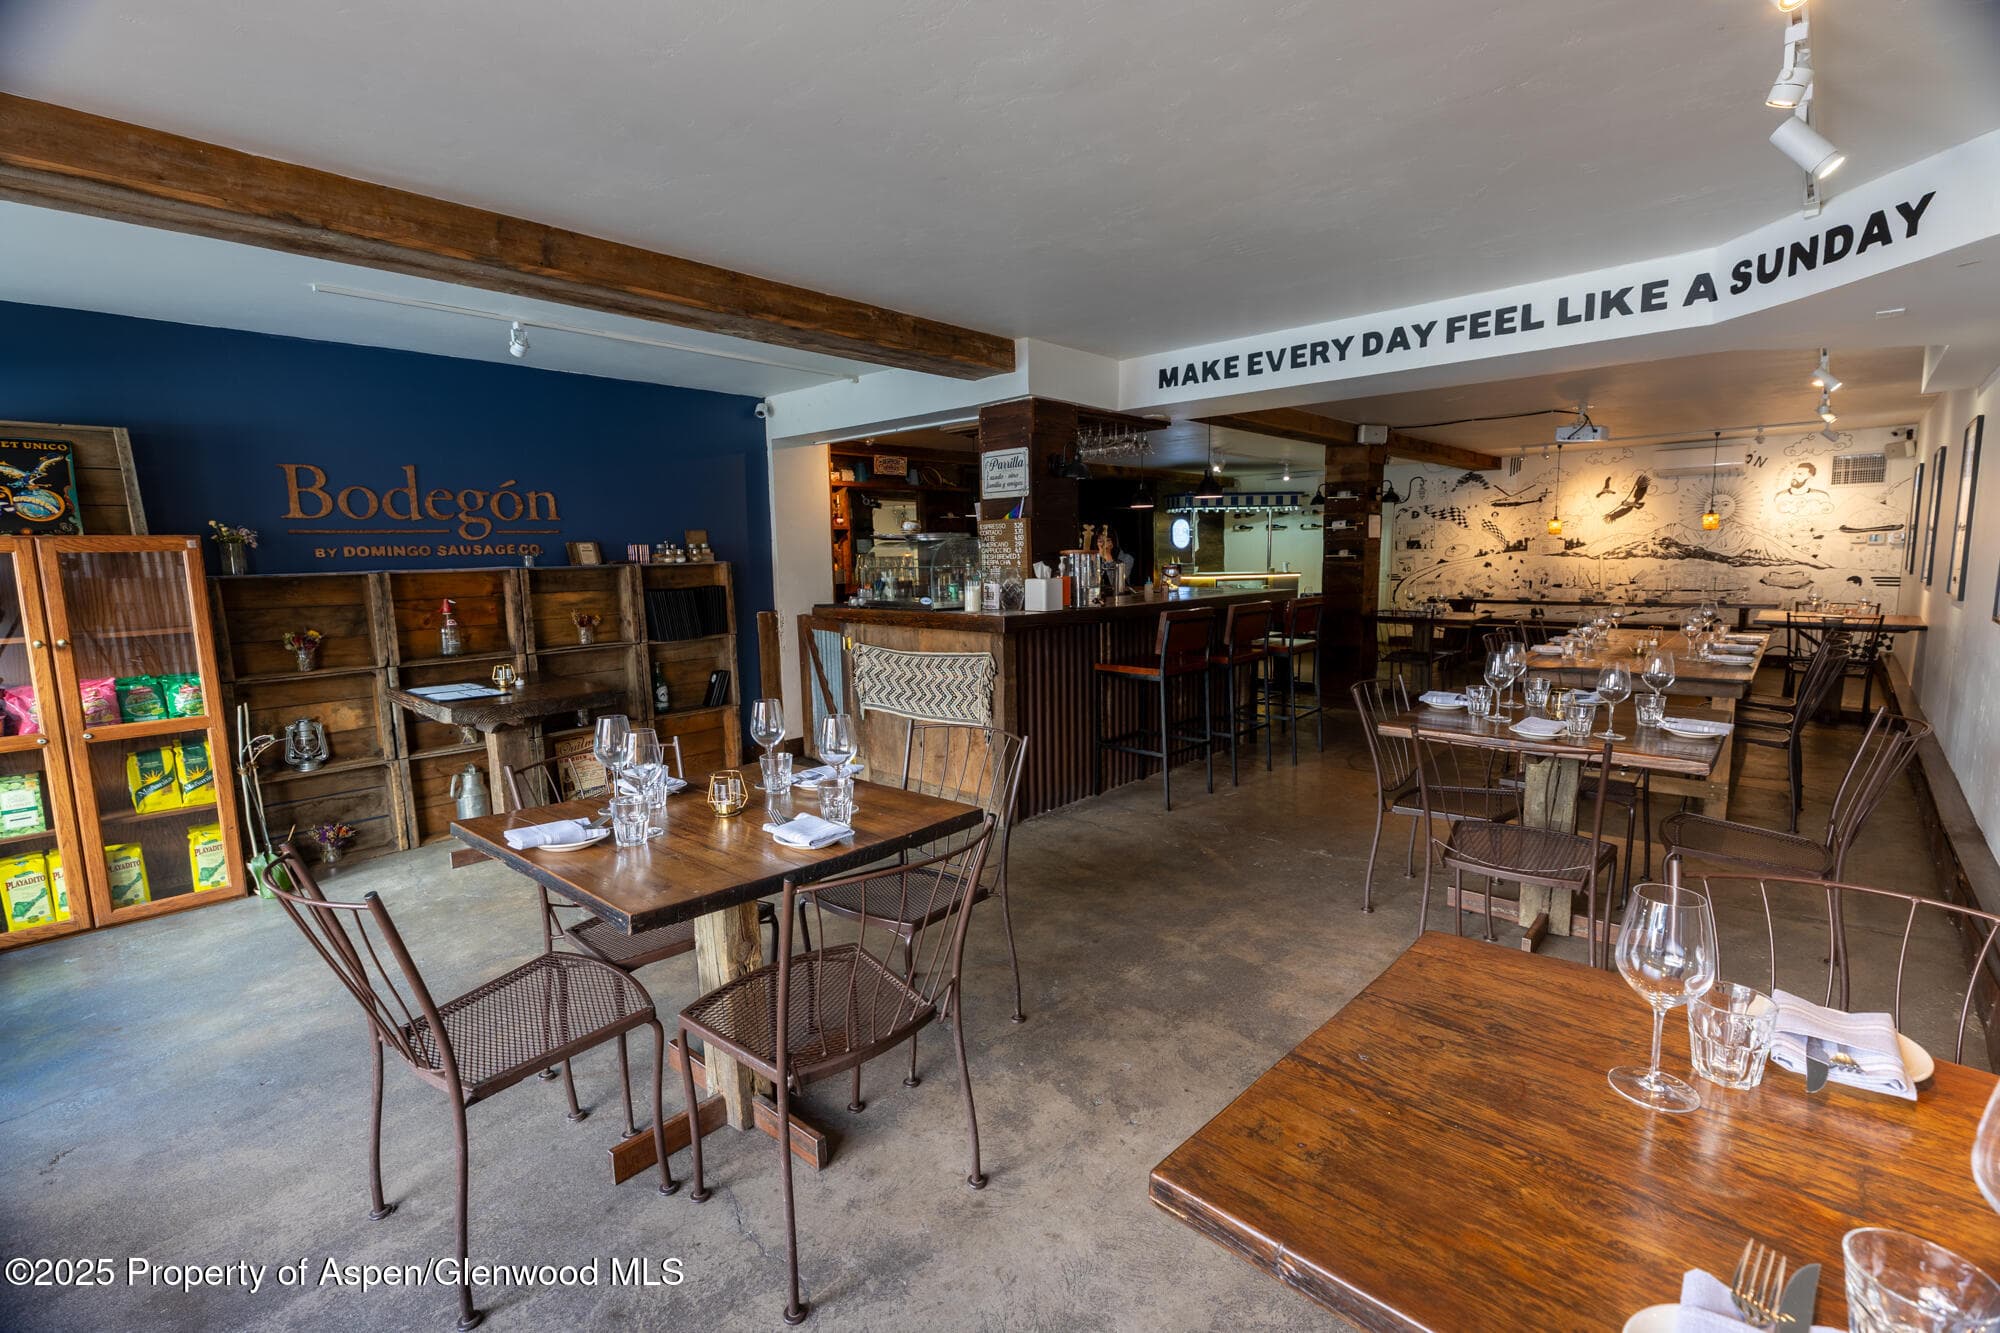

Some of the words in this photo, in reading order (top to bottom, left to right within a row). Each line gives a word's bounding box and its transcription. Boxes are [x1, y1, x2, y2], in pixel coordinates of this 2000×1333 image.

[1158, 355, 1240, 389] MAKE
[1247, 336, 1355, 376] EVERY
[1361, 320, 1438, 358] DAY
[1445, 303, 1545, 344] FEEL
[1556, 279, 1670, 327] LIKE
[1682, 272, 1718, 307] A
[1729, 190, 1937, 296] SUNDAY
[23, 442, 68, 451] UNICO
[989, 455, 1024, 471] Parrilla
[275, 463, 561, 541] Bodegón
[314, 548, 338, 559] BY
[342, 545, 431, 558] DOMINGO
[436, 544, 515, 556] SAUSAGE
[108, 860, 141, 873] LAYADITO
[5, 875, 46, 891] PLAYADITO
